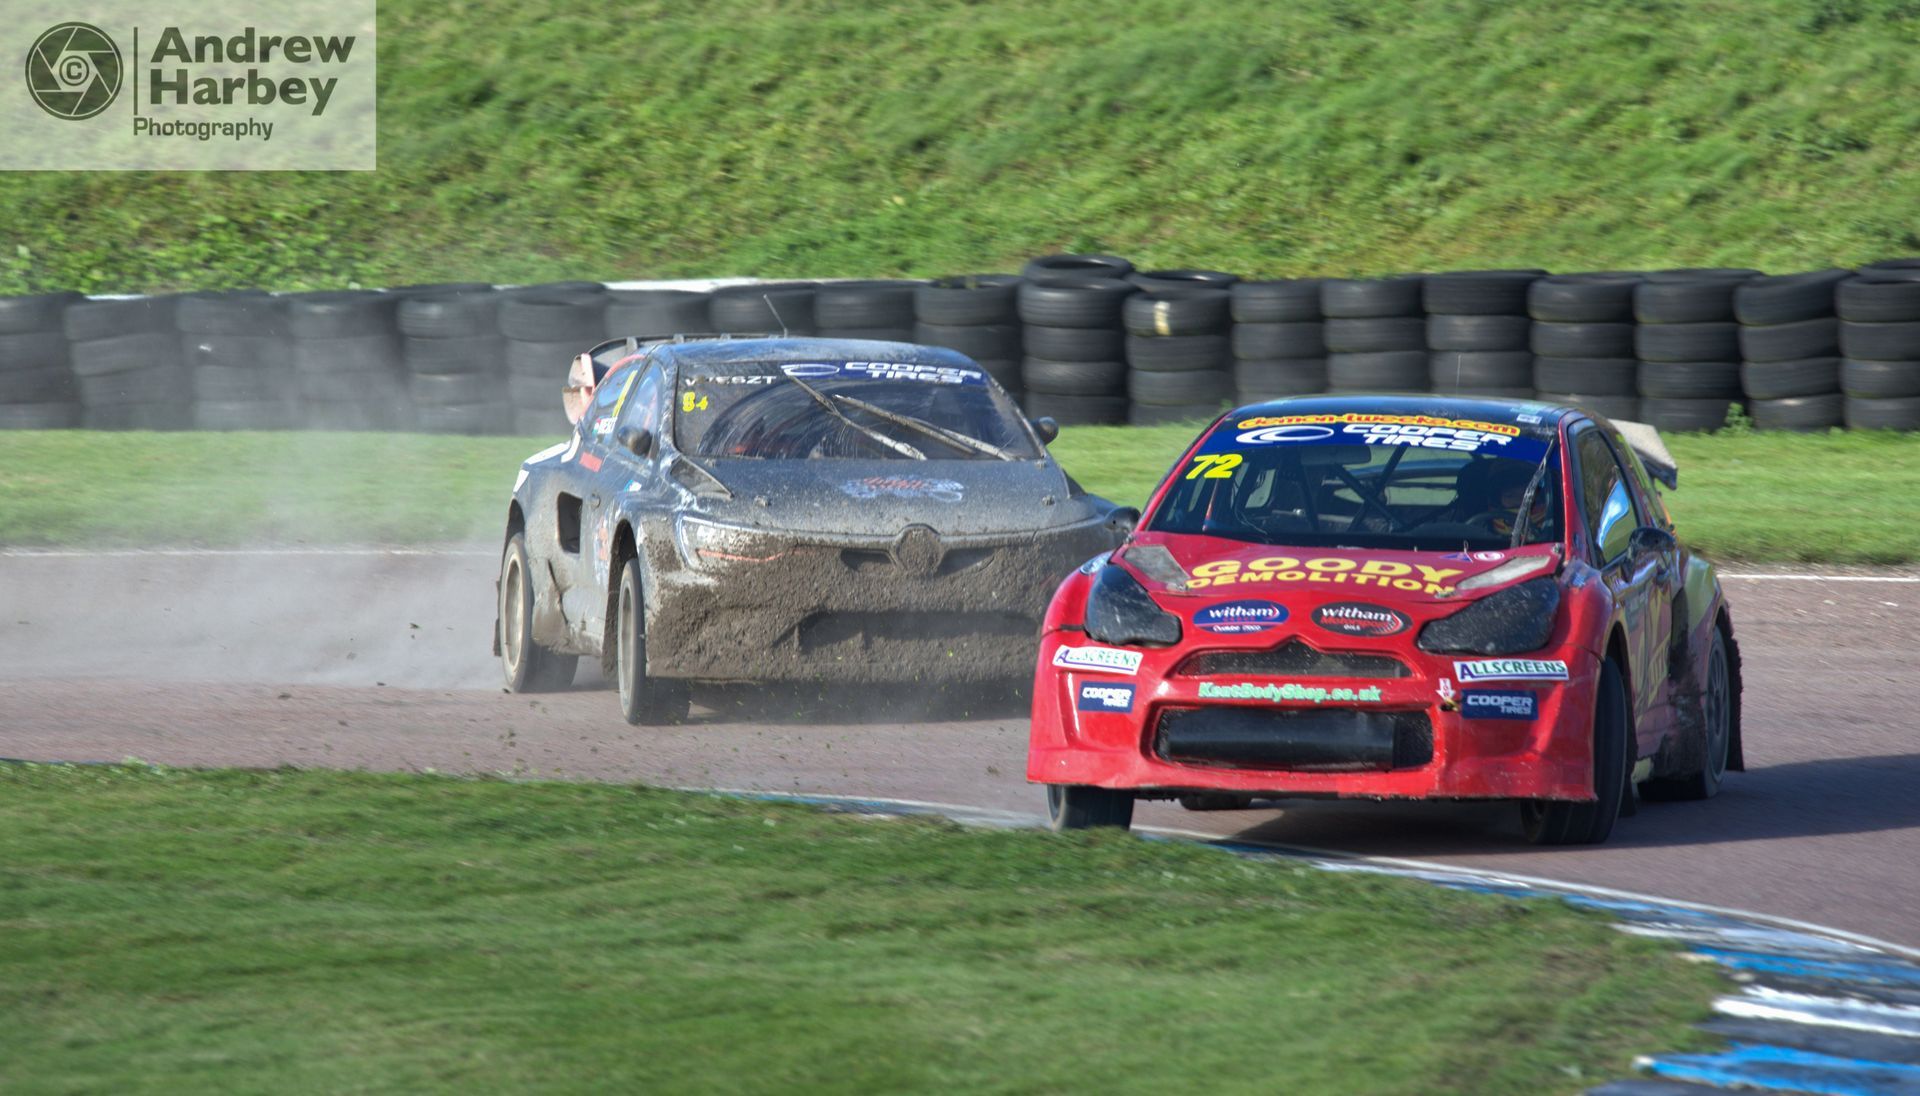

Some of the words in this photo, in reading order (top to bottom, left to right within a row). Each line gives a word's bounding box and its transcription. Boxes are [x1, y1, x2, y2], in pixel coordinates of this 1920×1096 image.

[845, 362, 982, 379] COOPER
[866, 370, 963, 384] TIRES
[1238, 413, 1520, 437] demon-tweeks.com
[1342, 424, 1512, 445] COOPER
[1363, 433, 1483, 451] TIRES
[1186, 453, 1243, 480] 72
[1192, 557, 1463, 583] GOODY
[1185, 571, 1455, 595] DEMOLITION
[1209, 606, 1274, 619] witham
[1322, 607, 1392, 621] witham
[1460, 660, 1566, 680] ALLSCREENS
[1467, 695, 1533, 707] COOPER
[1501, 705, 1531, 715] TIRES
